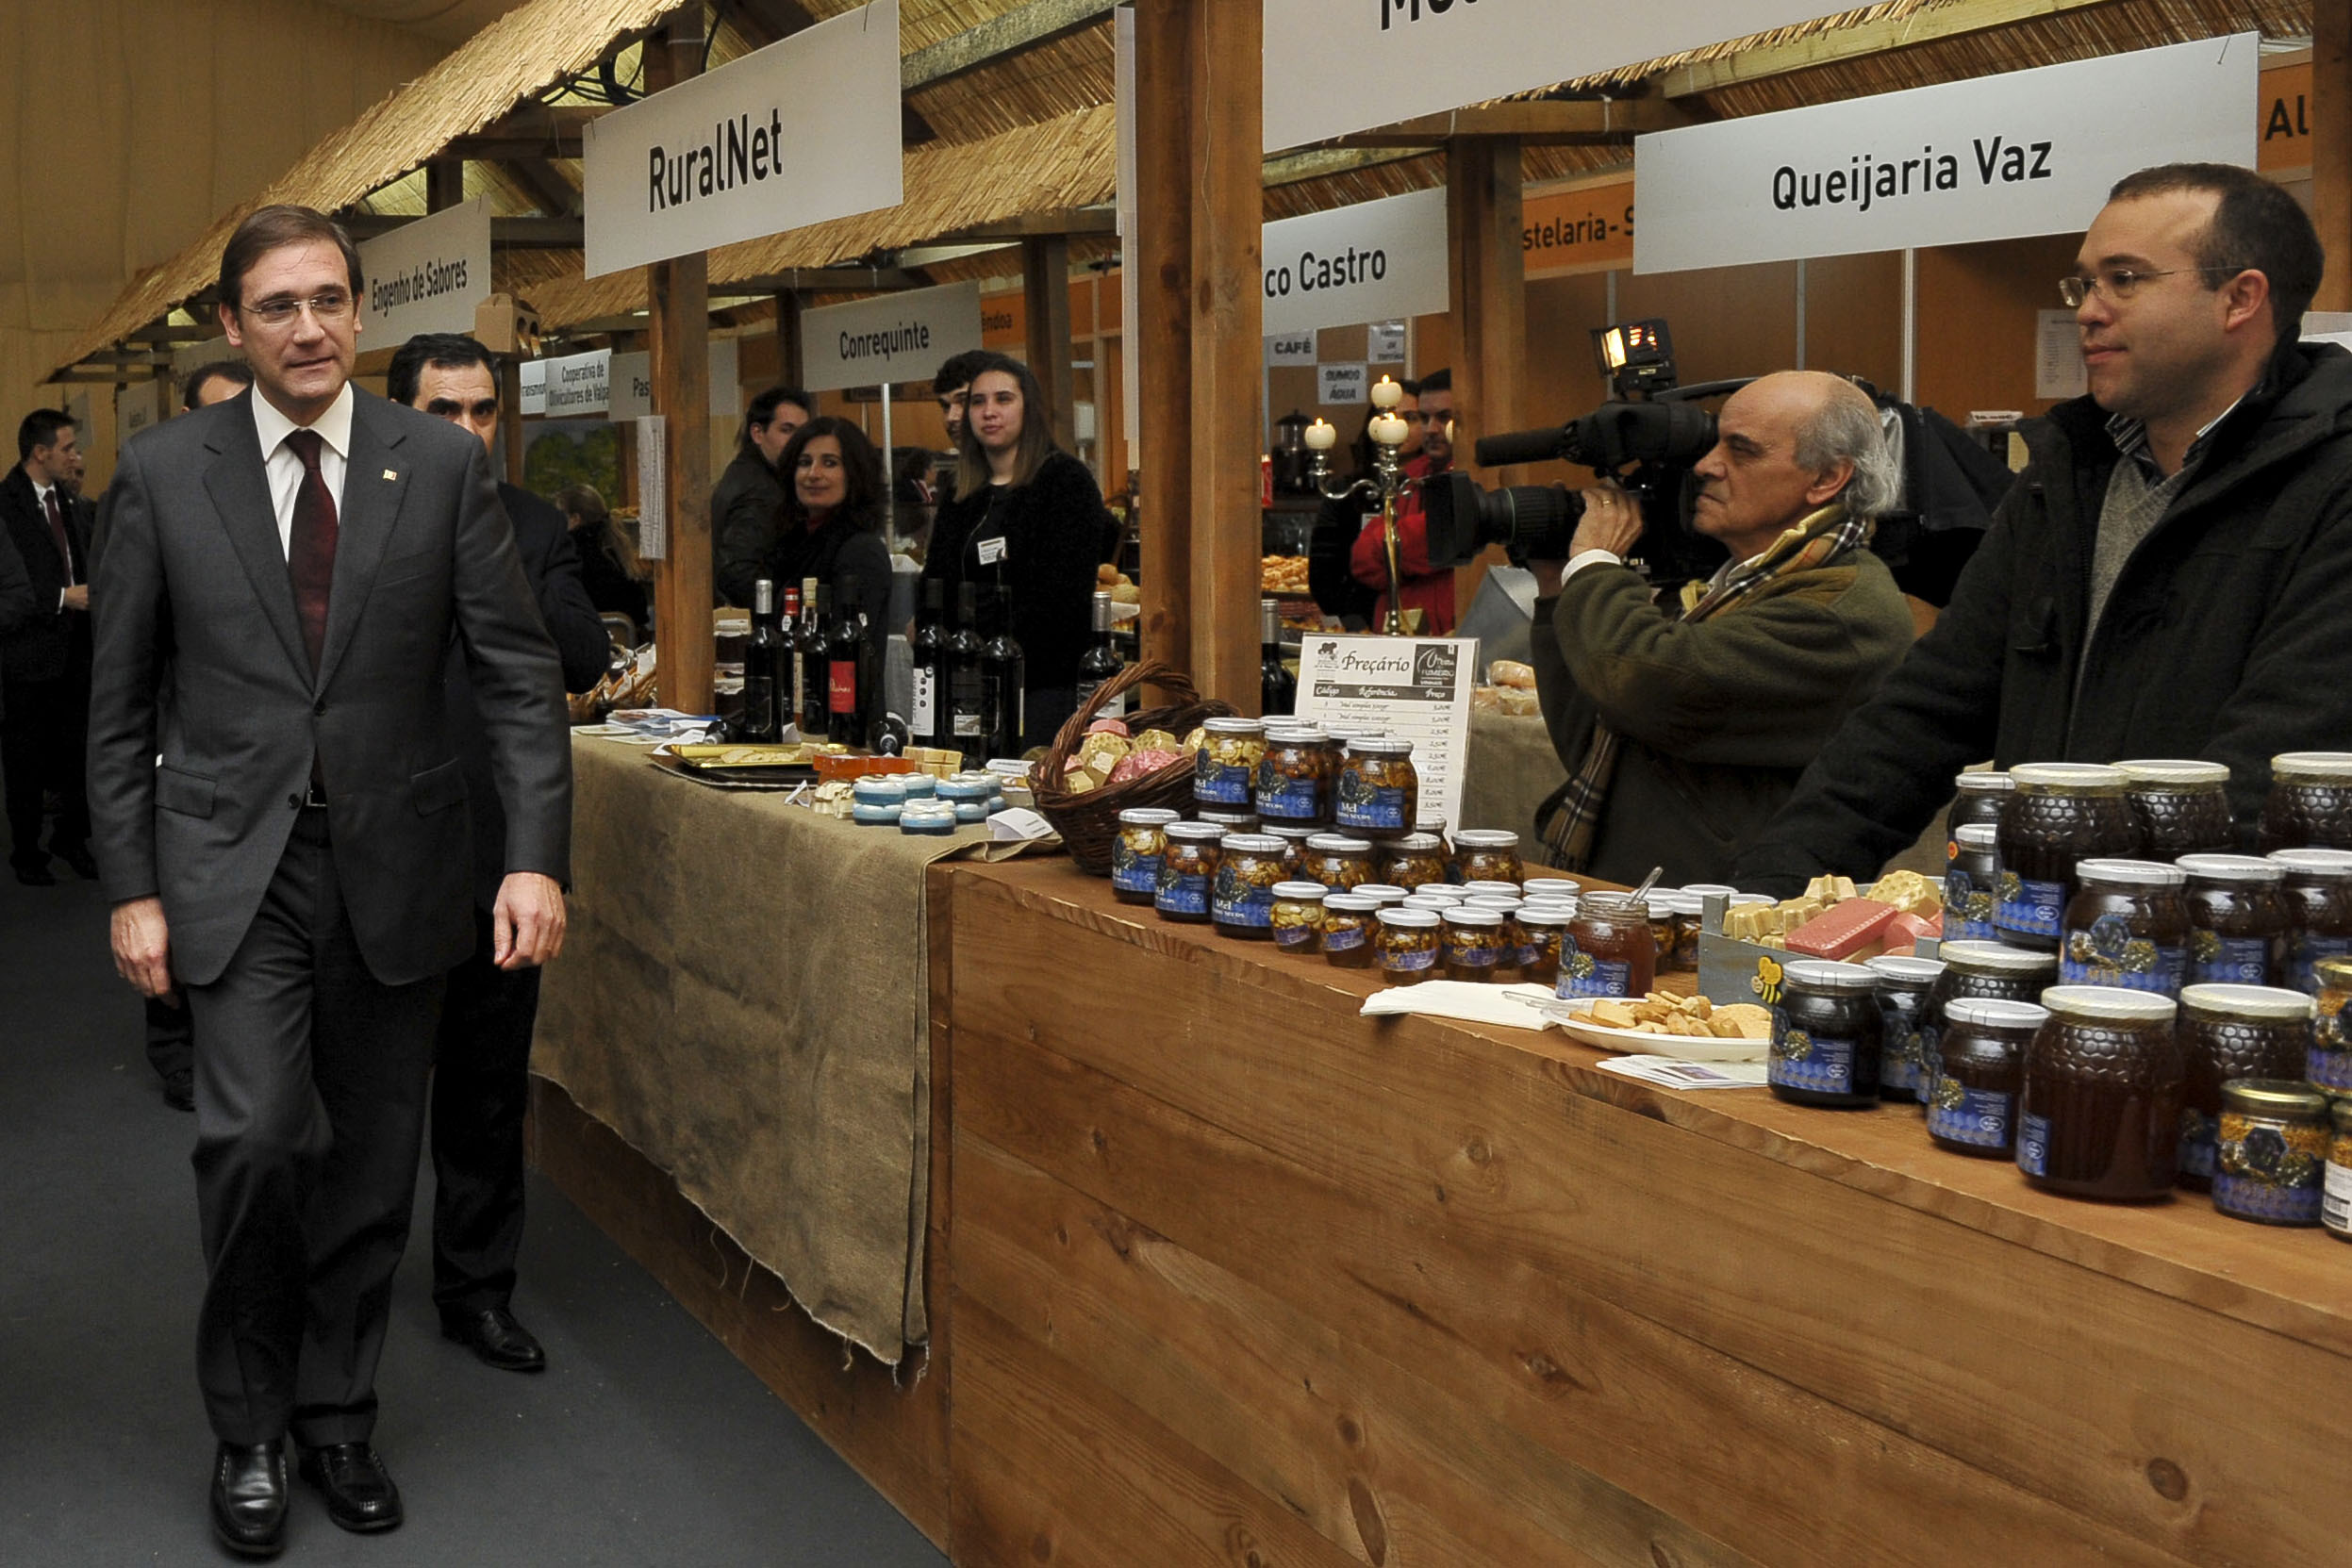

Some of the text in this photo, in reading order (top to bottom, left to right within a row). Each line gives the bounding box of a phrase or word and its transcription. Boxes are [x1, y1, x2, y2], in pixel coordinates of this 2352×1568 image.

[2264, 94, 2310, 141] Al
[650, 107, 782, 212] RuralNet
[1772, 135, 2052, 212] Queijaria Vaz
[372, 256, 468, 317] Engenho de Sabores
[1265, 246, 1387, 298] co Castro
[839, 322, 930, 361] Conrequinte
[1274, 337, 1313, 355] CAFÉ
[561, 359, 605, 386] Cooperativa de
[1329, 384, 1357, 400] ÁGUA
[585, 385, 593, 403] de
[1341, 650, 1411, 674] Preçário
